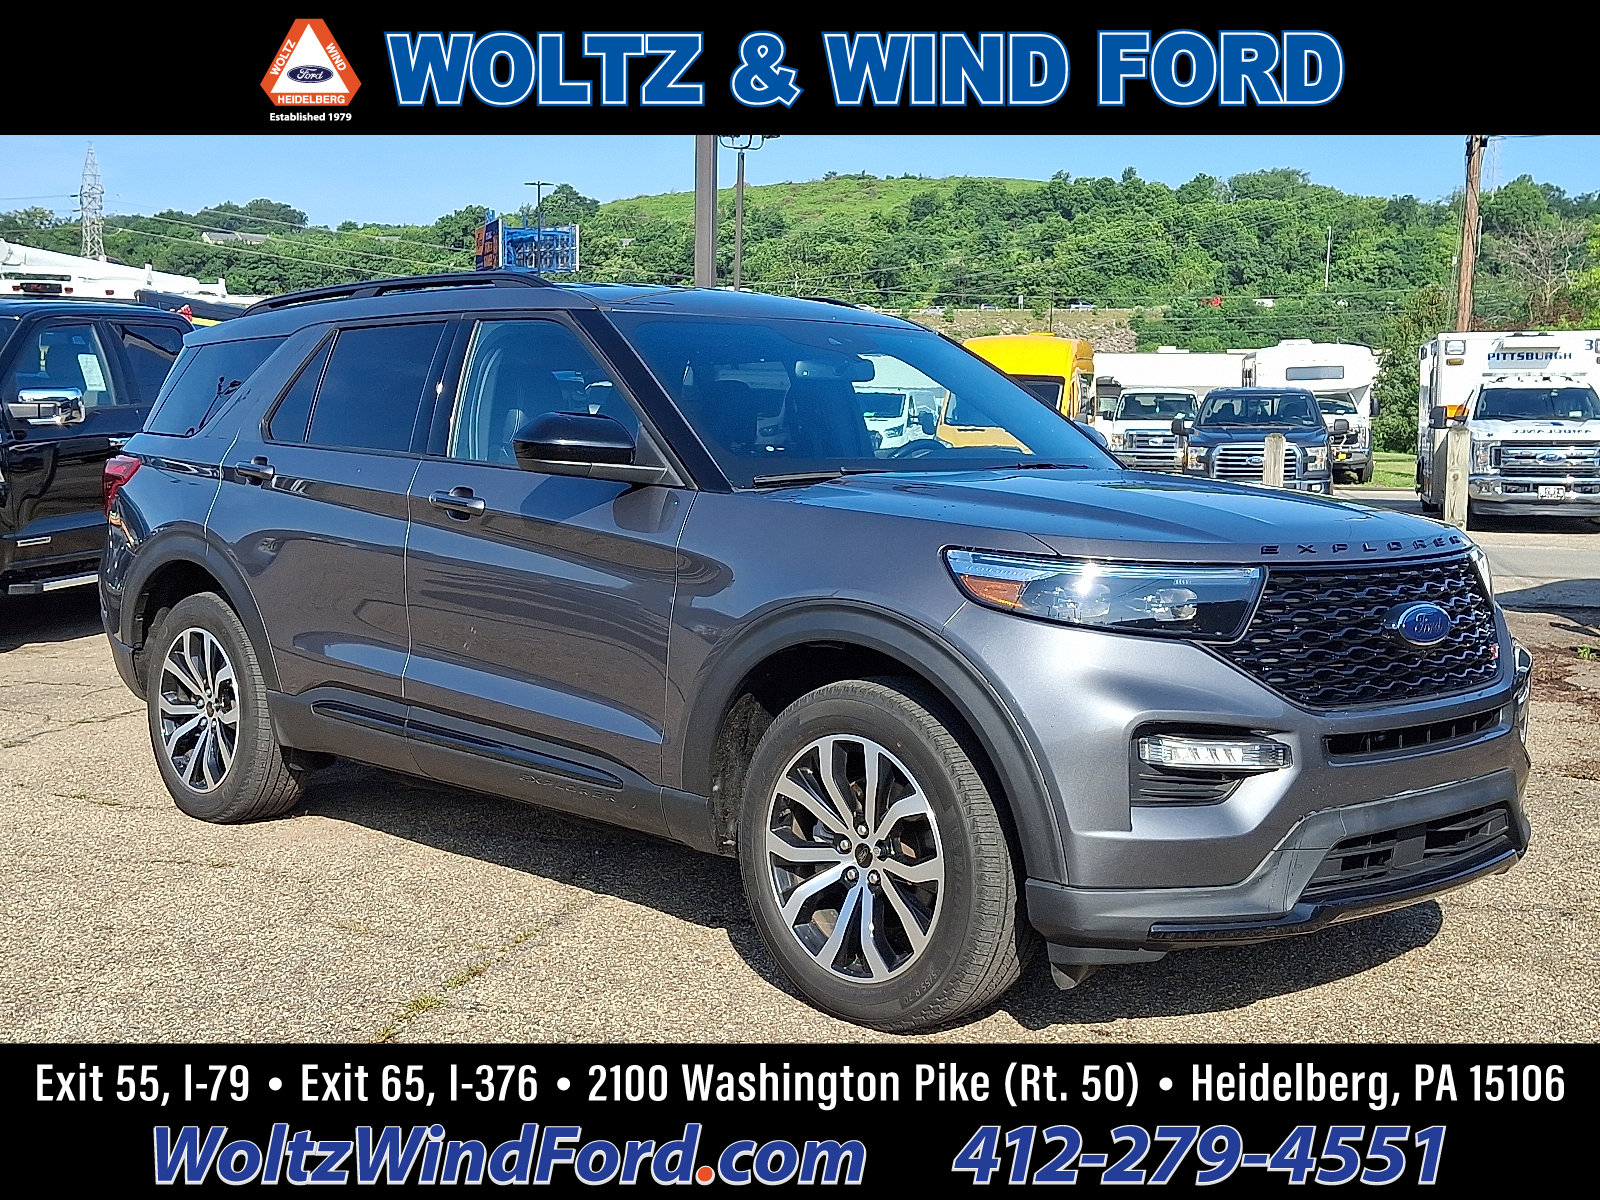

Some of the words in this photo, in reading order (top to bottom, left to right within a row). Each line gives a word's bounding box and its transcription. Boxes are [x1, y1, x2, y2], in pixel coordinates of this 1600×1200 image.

[1487, 351, 1572, 361] PITTSBURGH
[1261, 535, 1461, 555] EXPLORER
[1414, 611, 1443, 635] Ford
